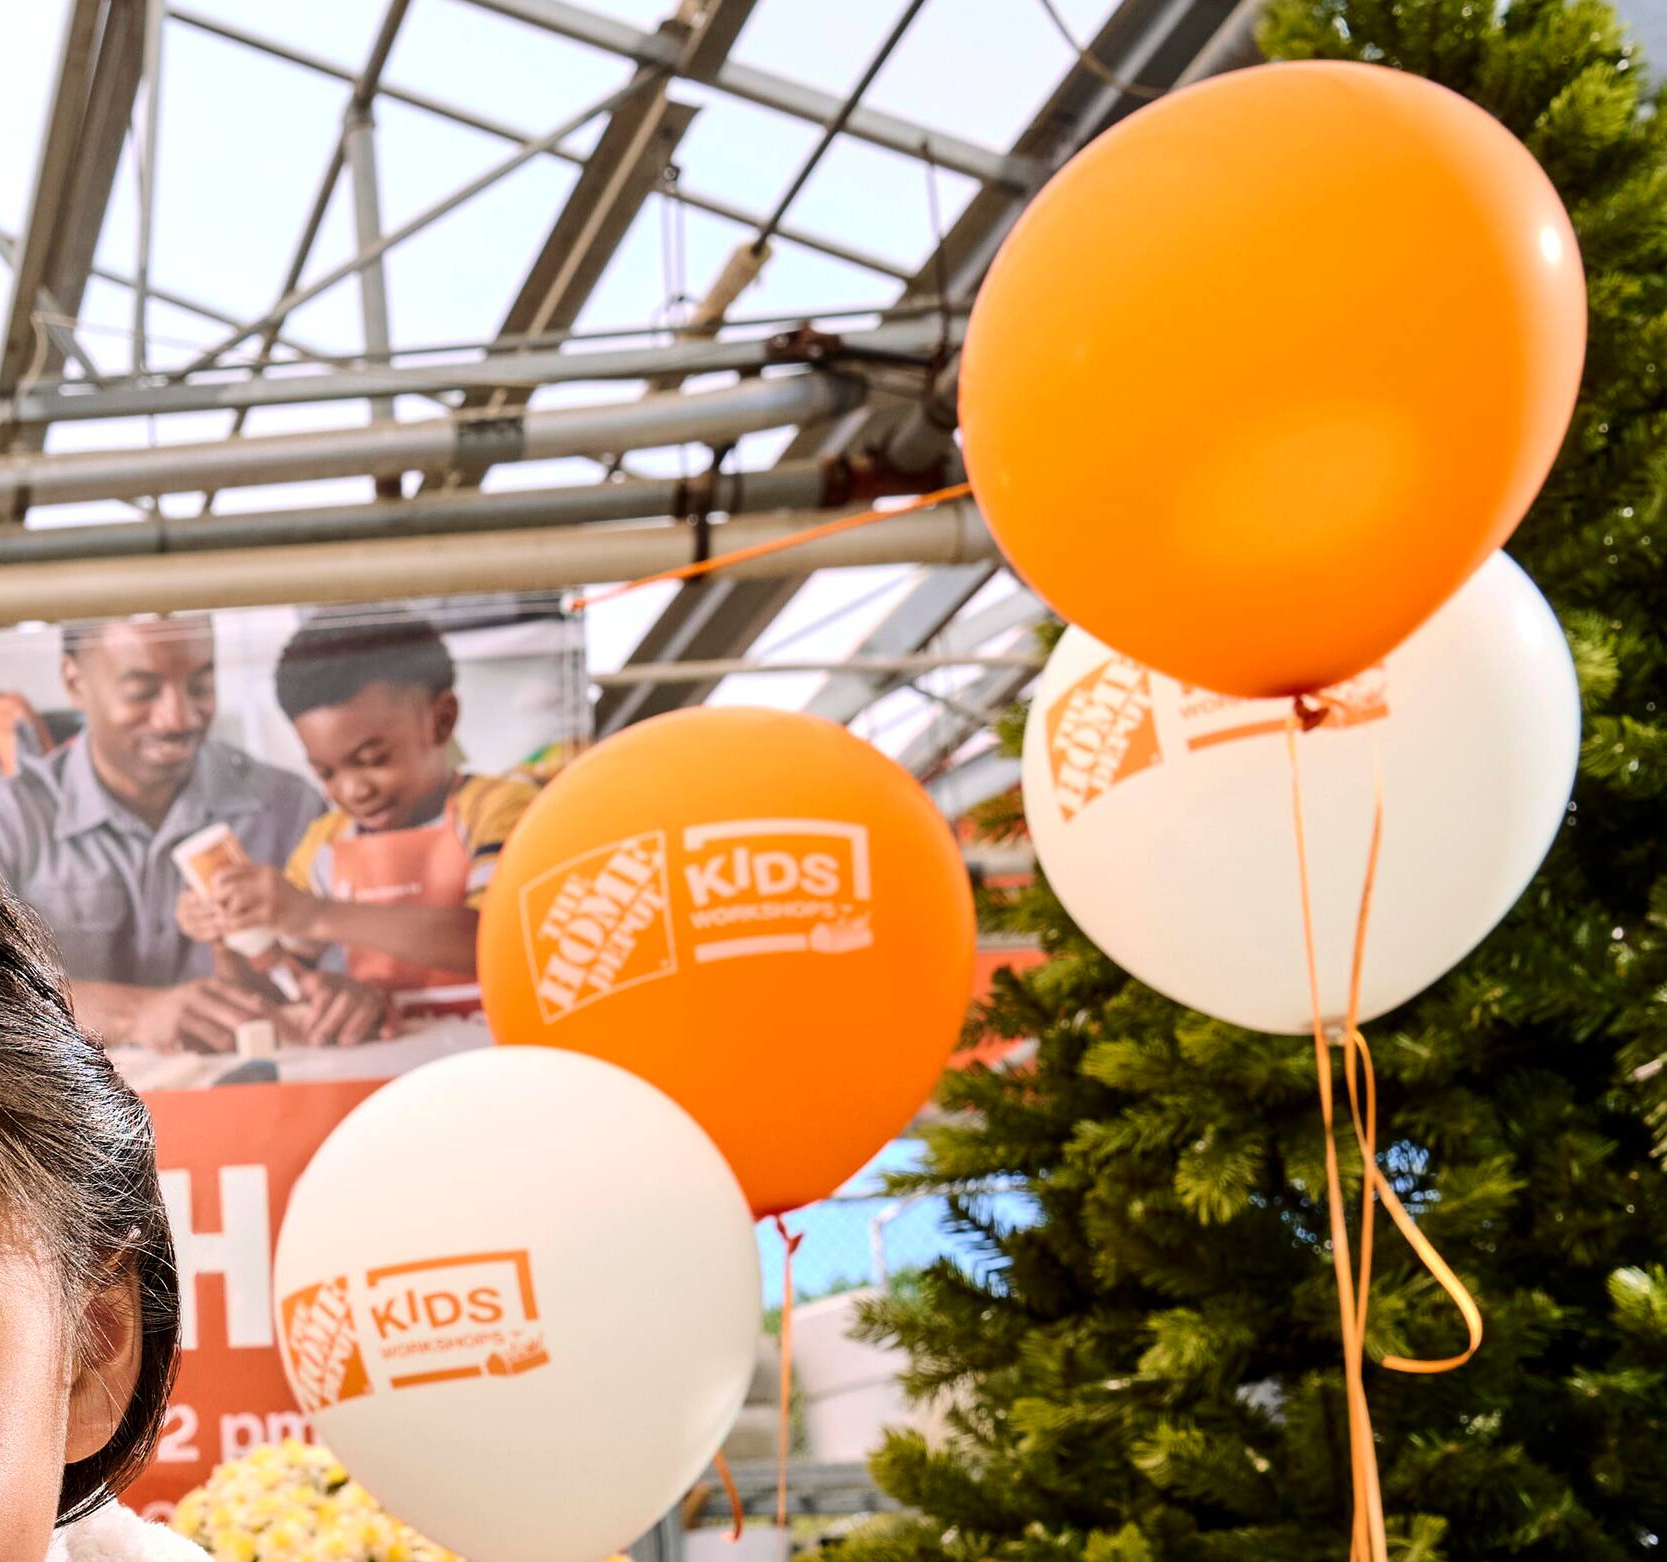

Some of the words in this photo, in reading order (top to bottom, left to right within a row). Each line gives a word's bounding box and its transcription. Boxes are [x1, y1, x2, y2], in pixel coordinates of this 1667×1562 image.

[683, 846, 840, 906] KIDS
[538, 873, 593, 941] THE
[540, 839, 664, 1012] HOME
[690, 900, 832, 929] WORKSHOPS
[588, 883, 666, 992] DEPOT
[370, 1285, 503, 1339] KIDS
[381, 1331, 505, 1359] WORKSHOPS
